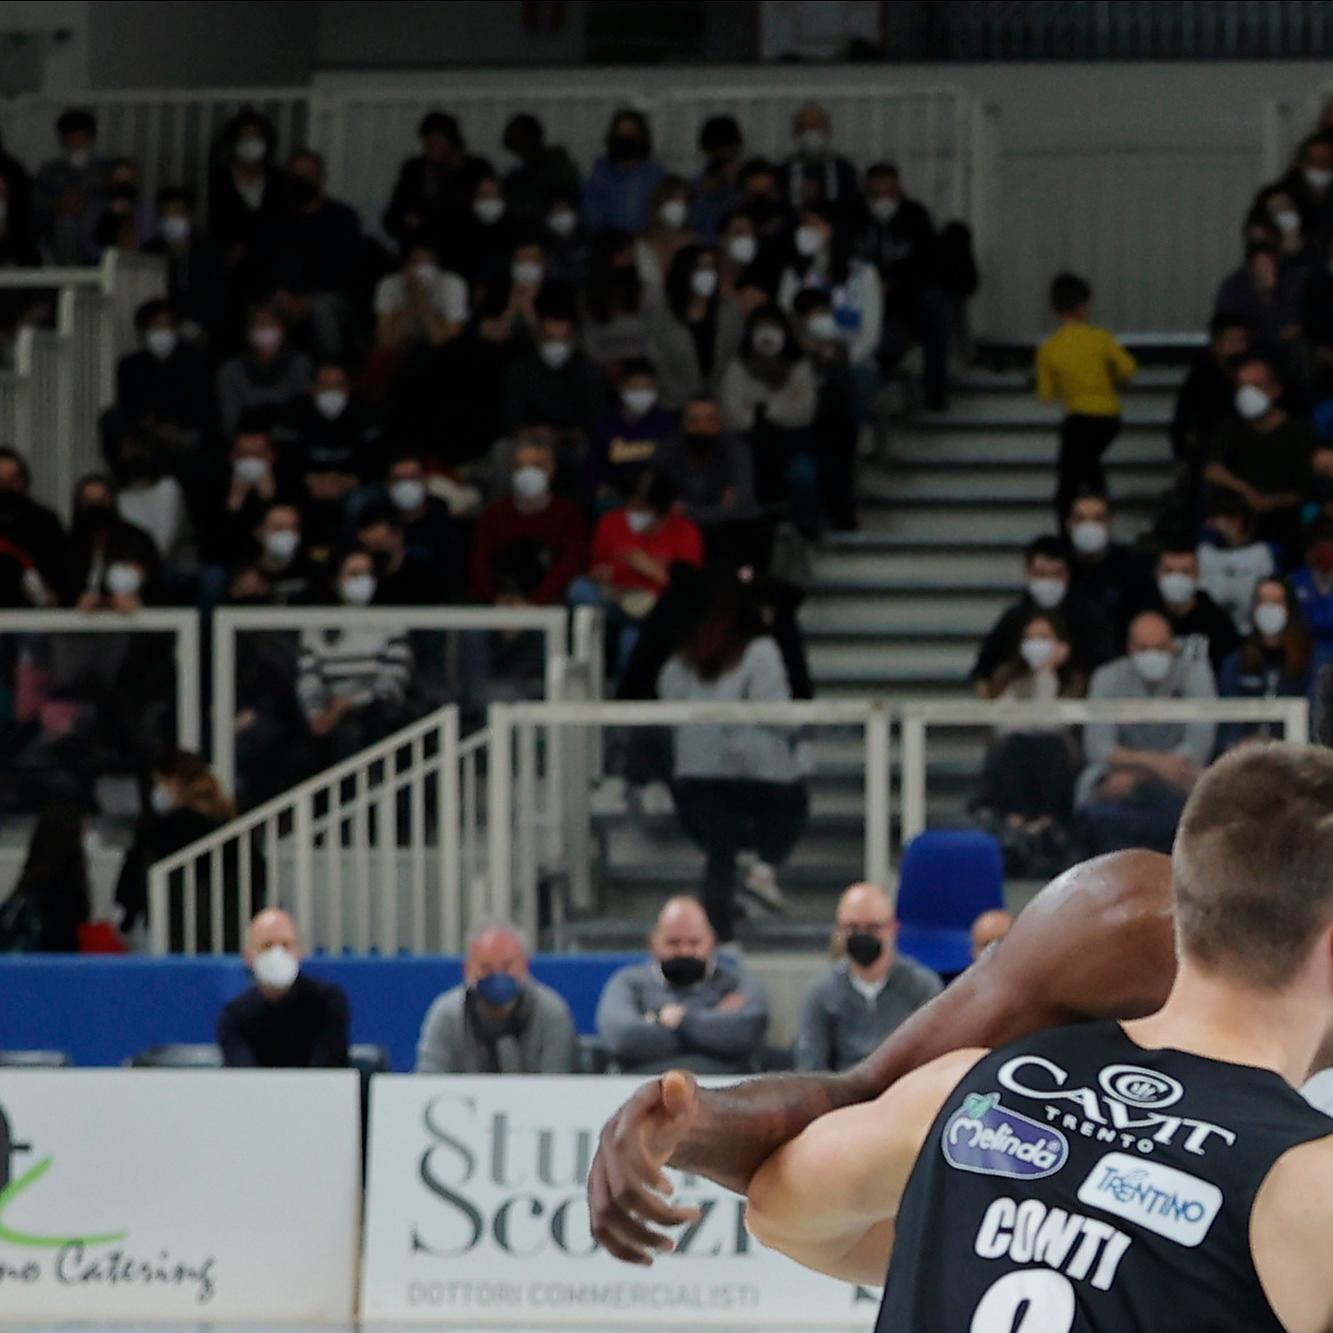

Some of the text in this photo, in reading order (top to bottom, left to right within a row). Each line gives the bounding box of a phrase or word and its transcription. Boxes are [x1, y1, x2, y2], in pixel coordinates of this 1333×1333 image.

[948, 1113, 1058, 1172] Melinda
[1044, 1104, 1155, 1155] TRENTO
[1097, 1165, 1206, 1224] TRENTINO
[55, 1240, 216, 1305] Catering
[974, 1196, 1133, 1293] CONTI
[407, 1280, 761, 1310] DOTTORI COMMERCIALISTI
